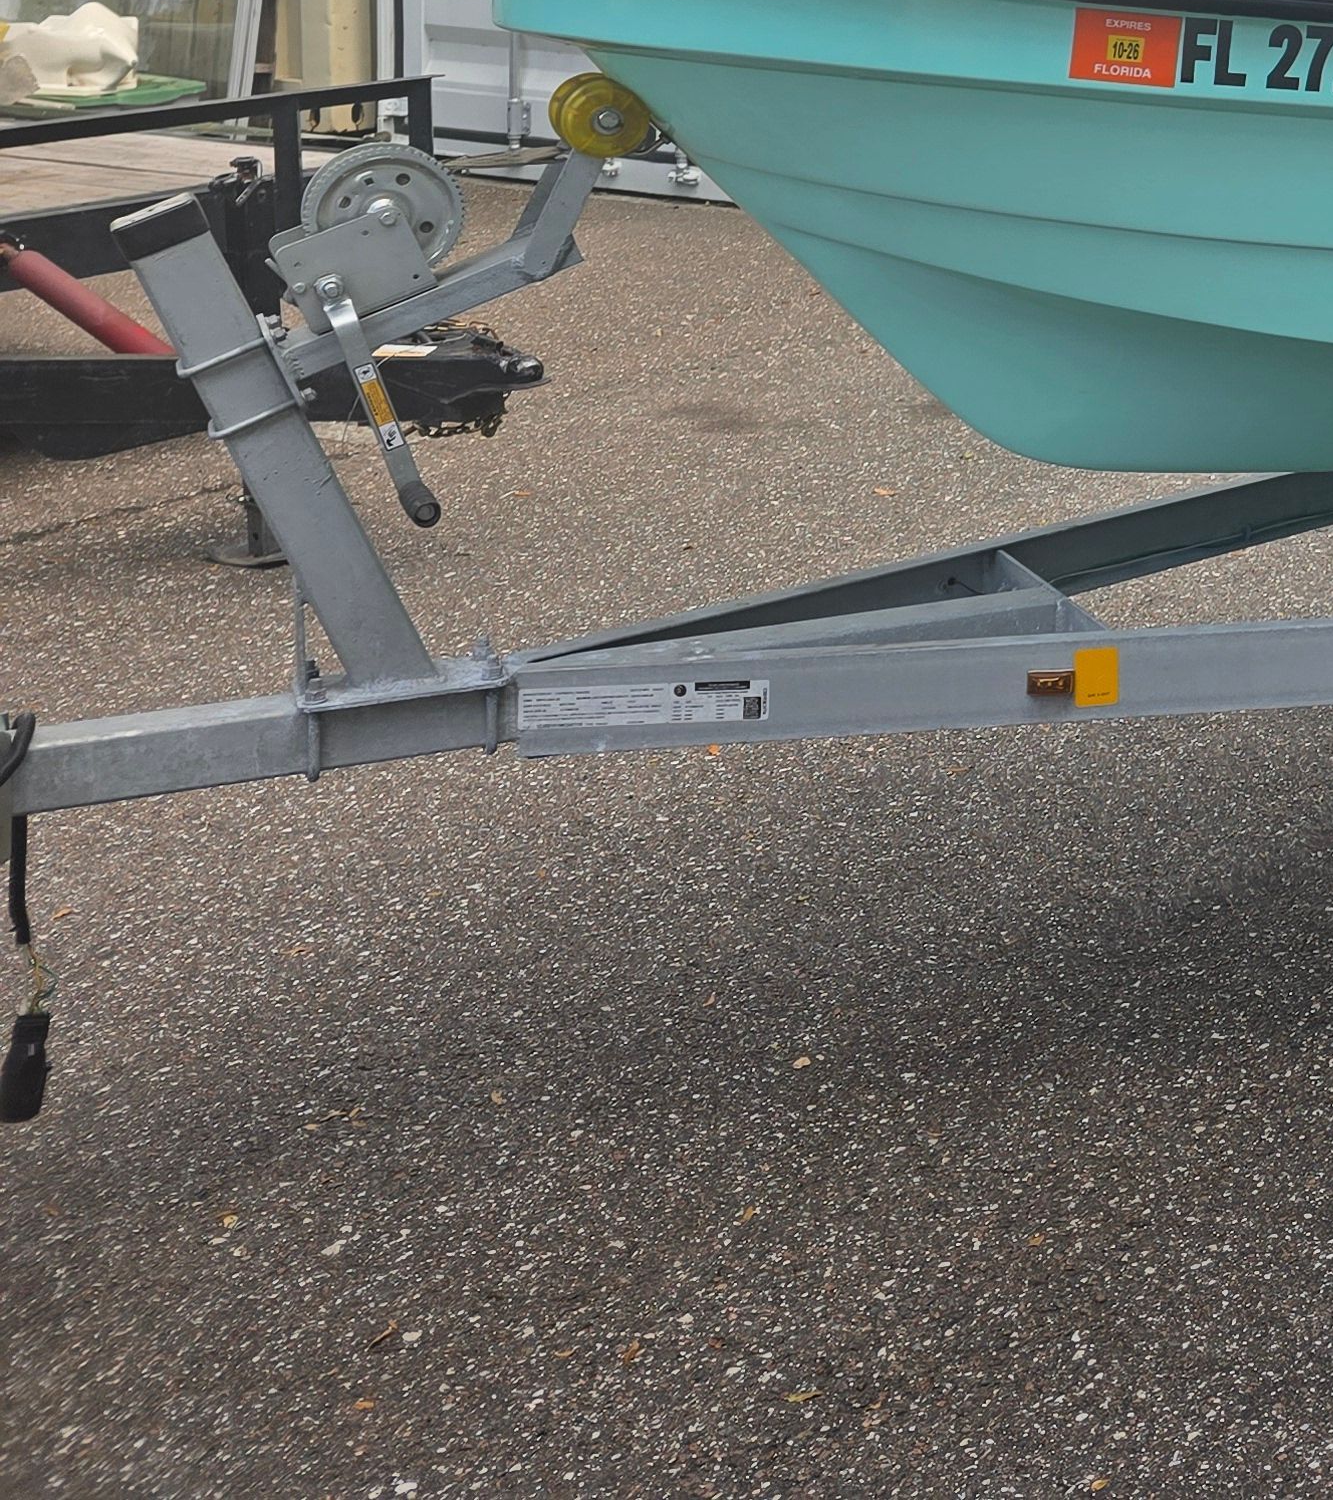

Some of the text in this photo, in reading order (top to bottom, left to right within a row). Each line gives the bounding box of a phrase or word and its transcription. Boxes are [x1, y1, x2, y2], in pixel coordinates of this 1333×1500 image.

[1105, 18, 1152, 31] EXPIRES
[1112, 41, 1140, 60] 10-26
[1180, 16, 1247, 87] FL
[1093, 63, 1152, 79] FLORIDA
